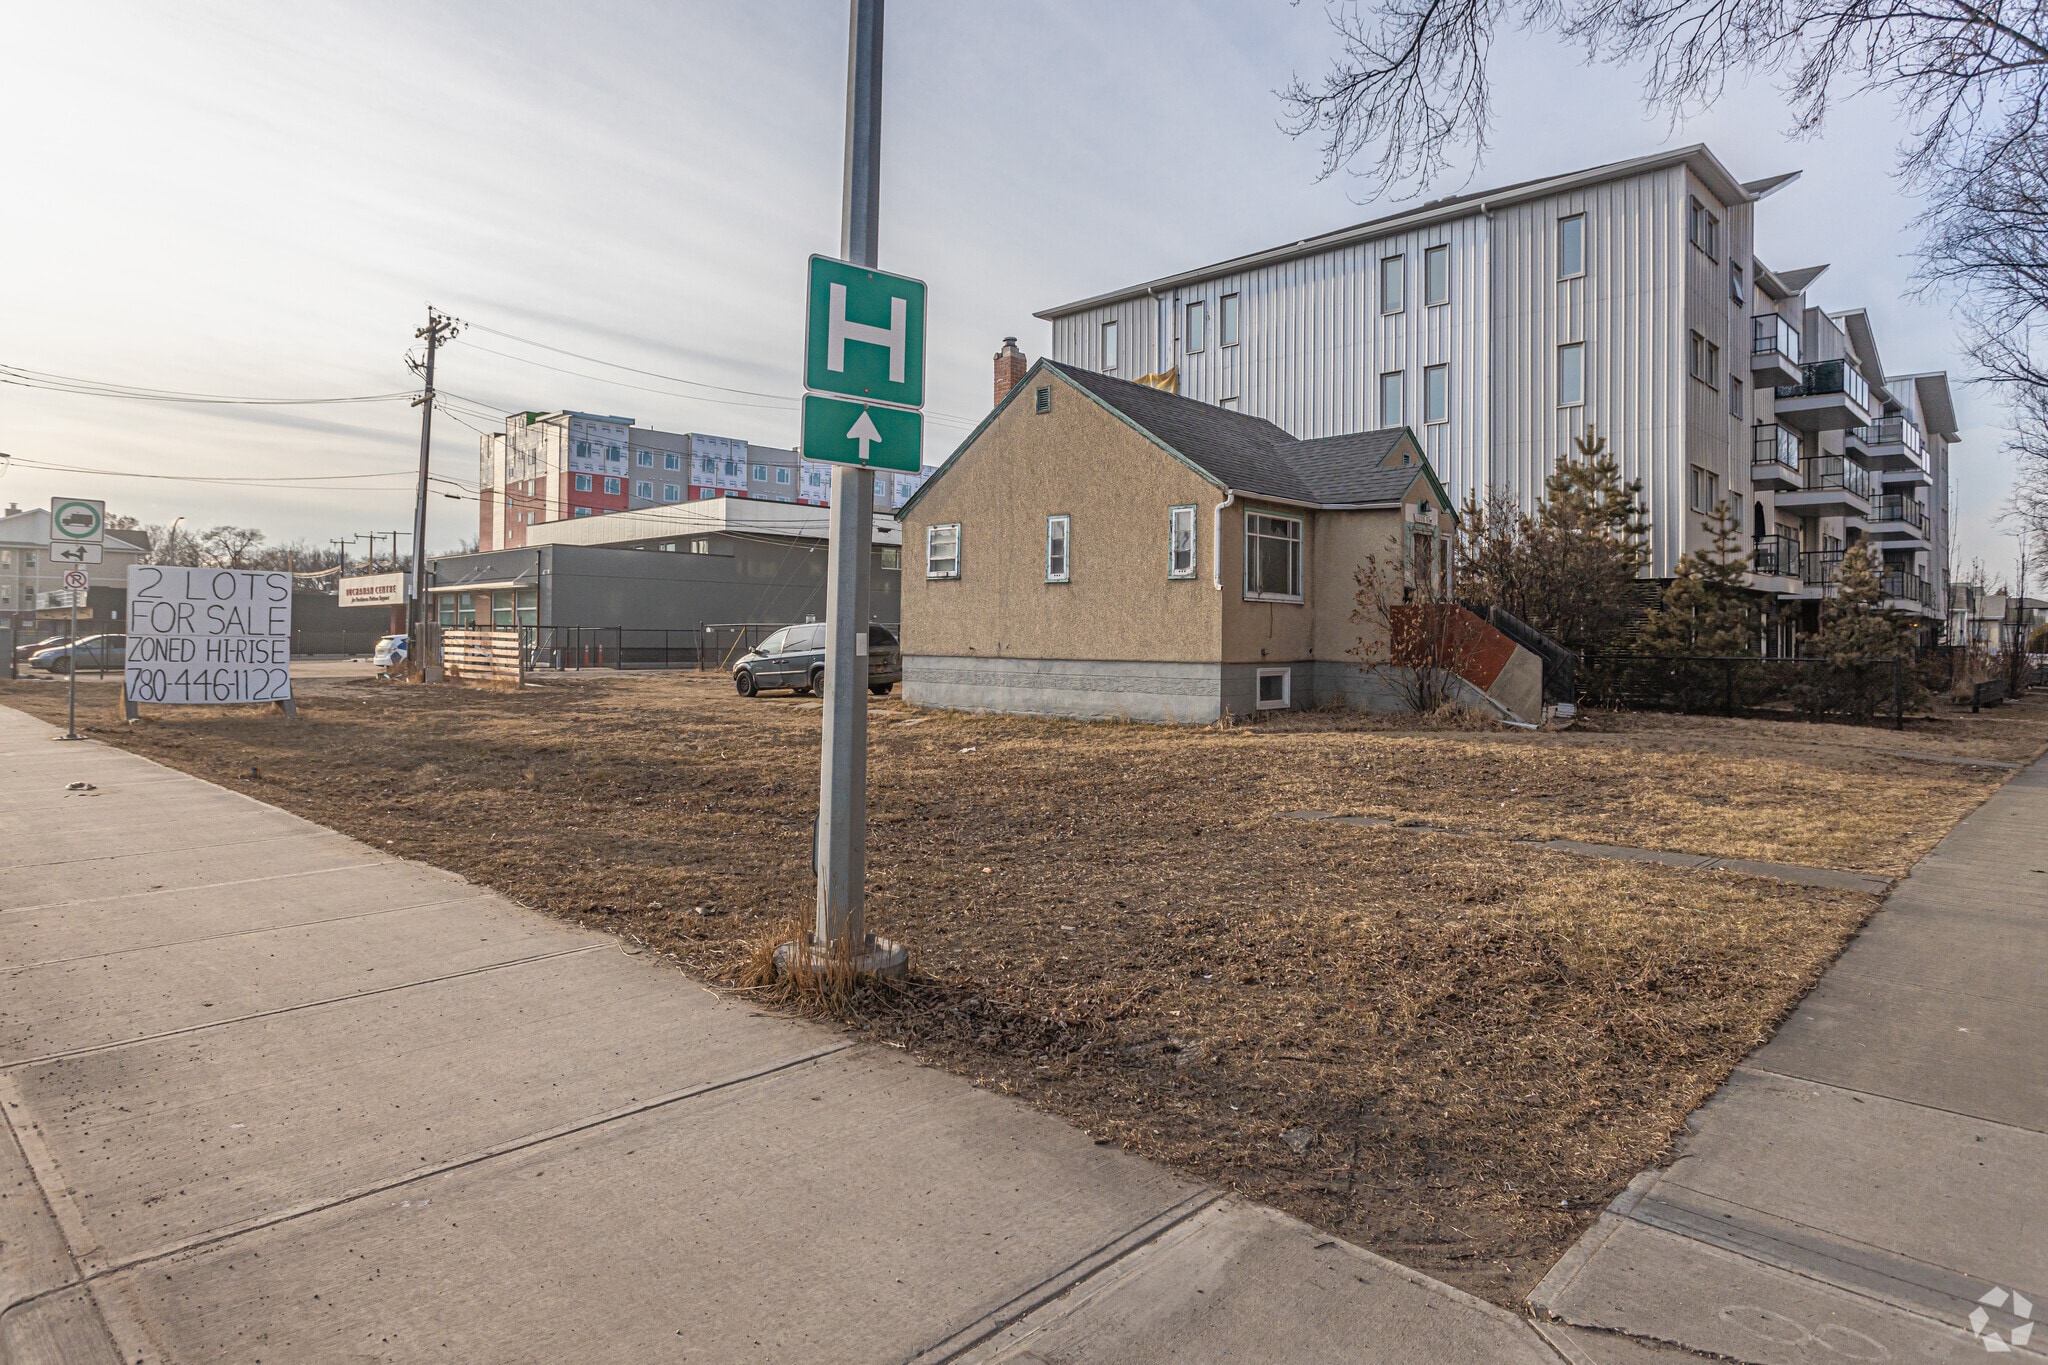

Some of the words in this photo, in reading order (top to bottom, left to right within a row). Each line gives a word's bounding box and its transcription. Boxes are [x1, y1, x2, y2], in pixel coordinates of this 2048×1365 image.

[827, 282, 907, 384] H
[137, 567, 163, 599] 2
[186, 570, 288, 602] LOTS
[375, 585, 396, 594] CENTRE
[131, 600, 196, 634] FOR
[207, 604, 288, 636] SALE
[128, 636, 196, 663] ZONED
[206, 638, 287, 664] HI-RISE
[127, 667, 289, 701] 780-446-1122
